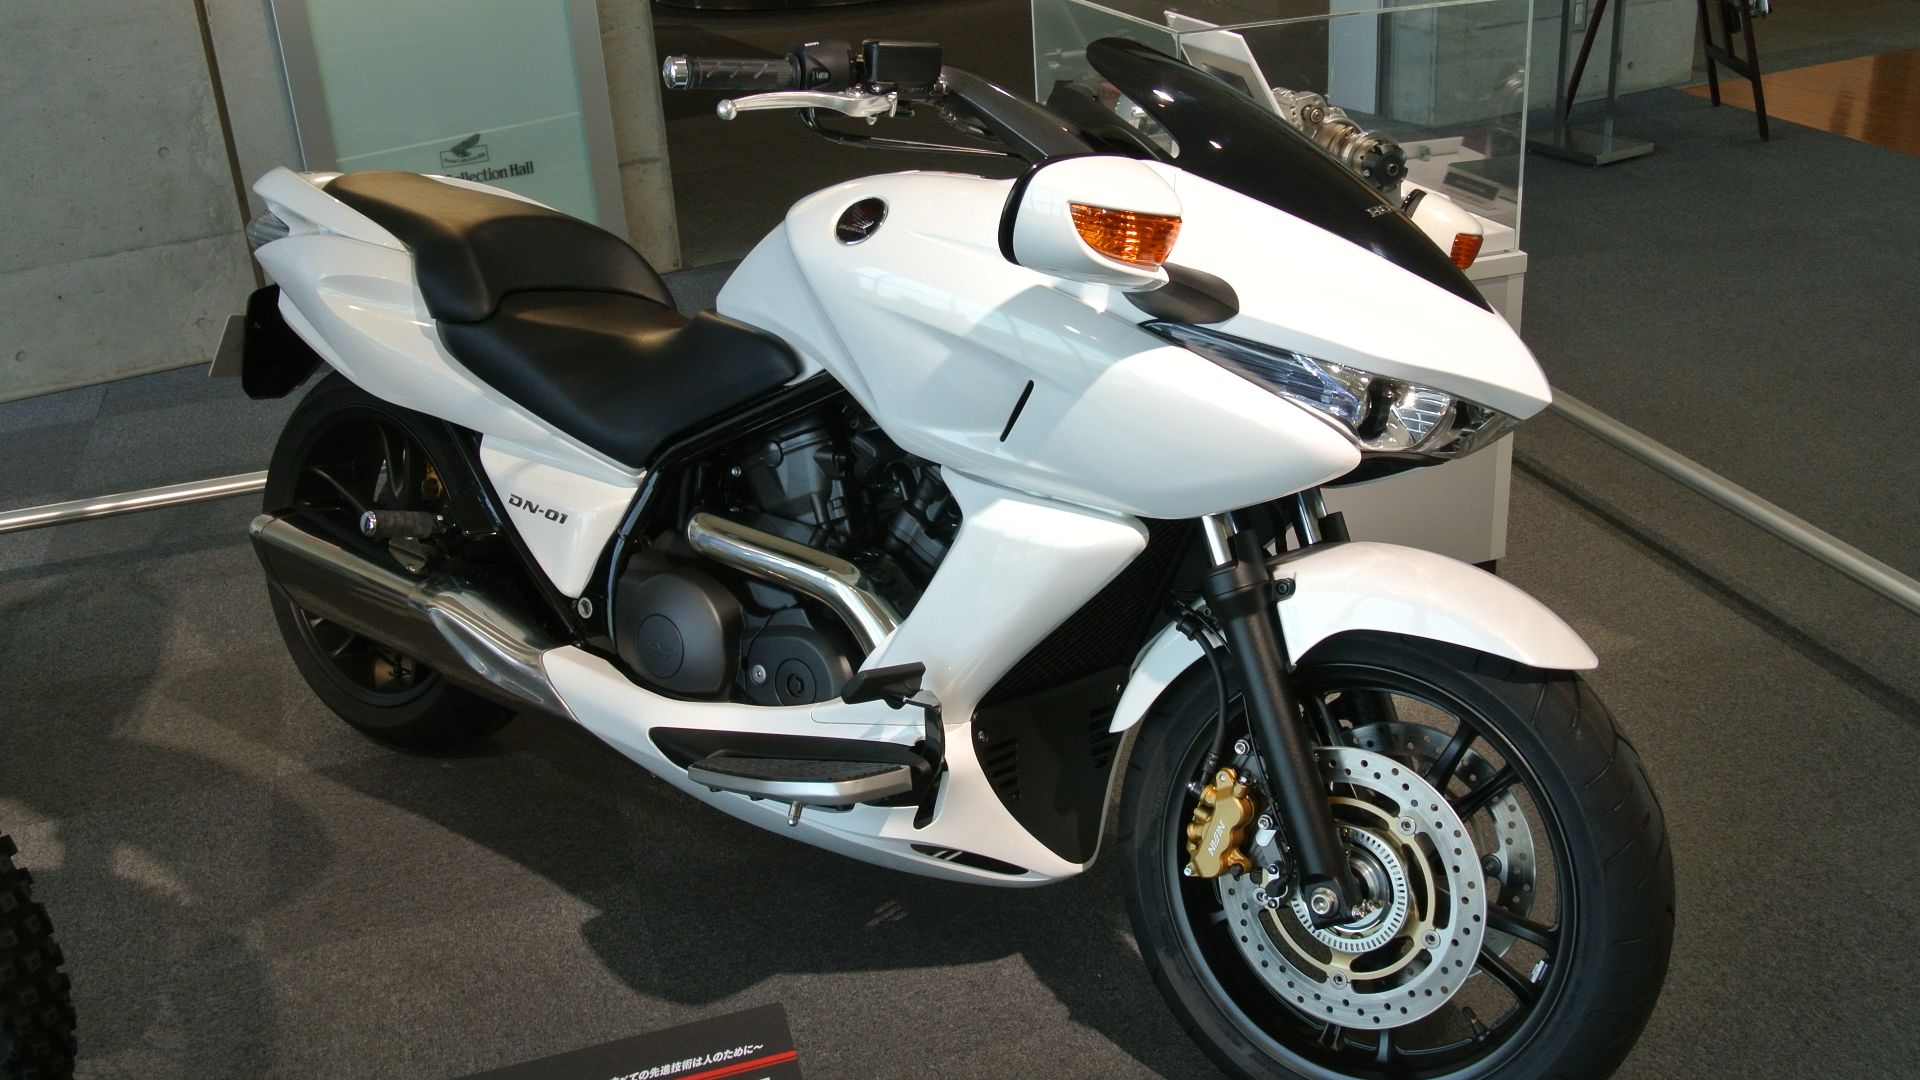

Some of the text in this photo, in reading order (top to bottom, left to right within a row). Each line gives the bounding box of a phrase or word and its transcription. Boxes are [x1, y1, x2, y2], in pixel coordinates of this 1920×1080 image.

[446, 161, 534, 182] llection Hall
[508, 493, 569, 525] DN-01
